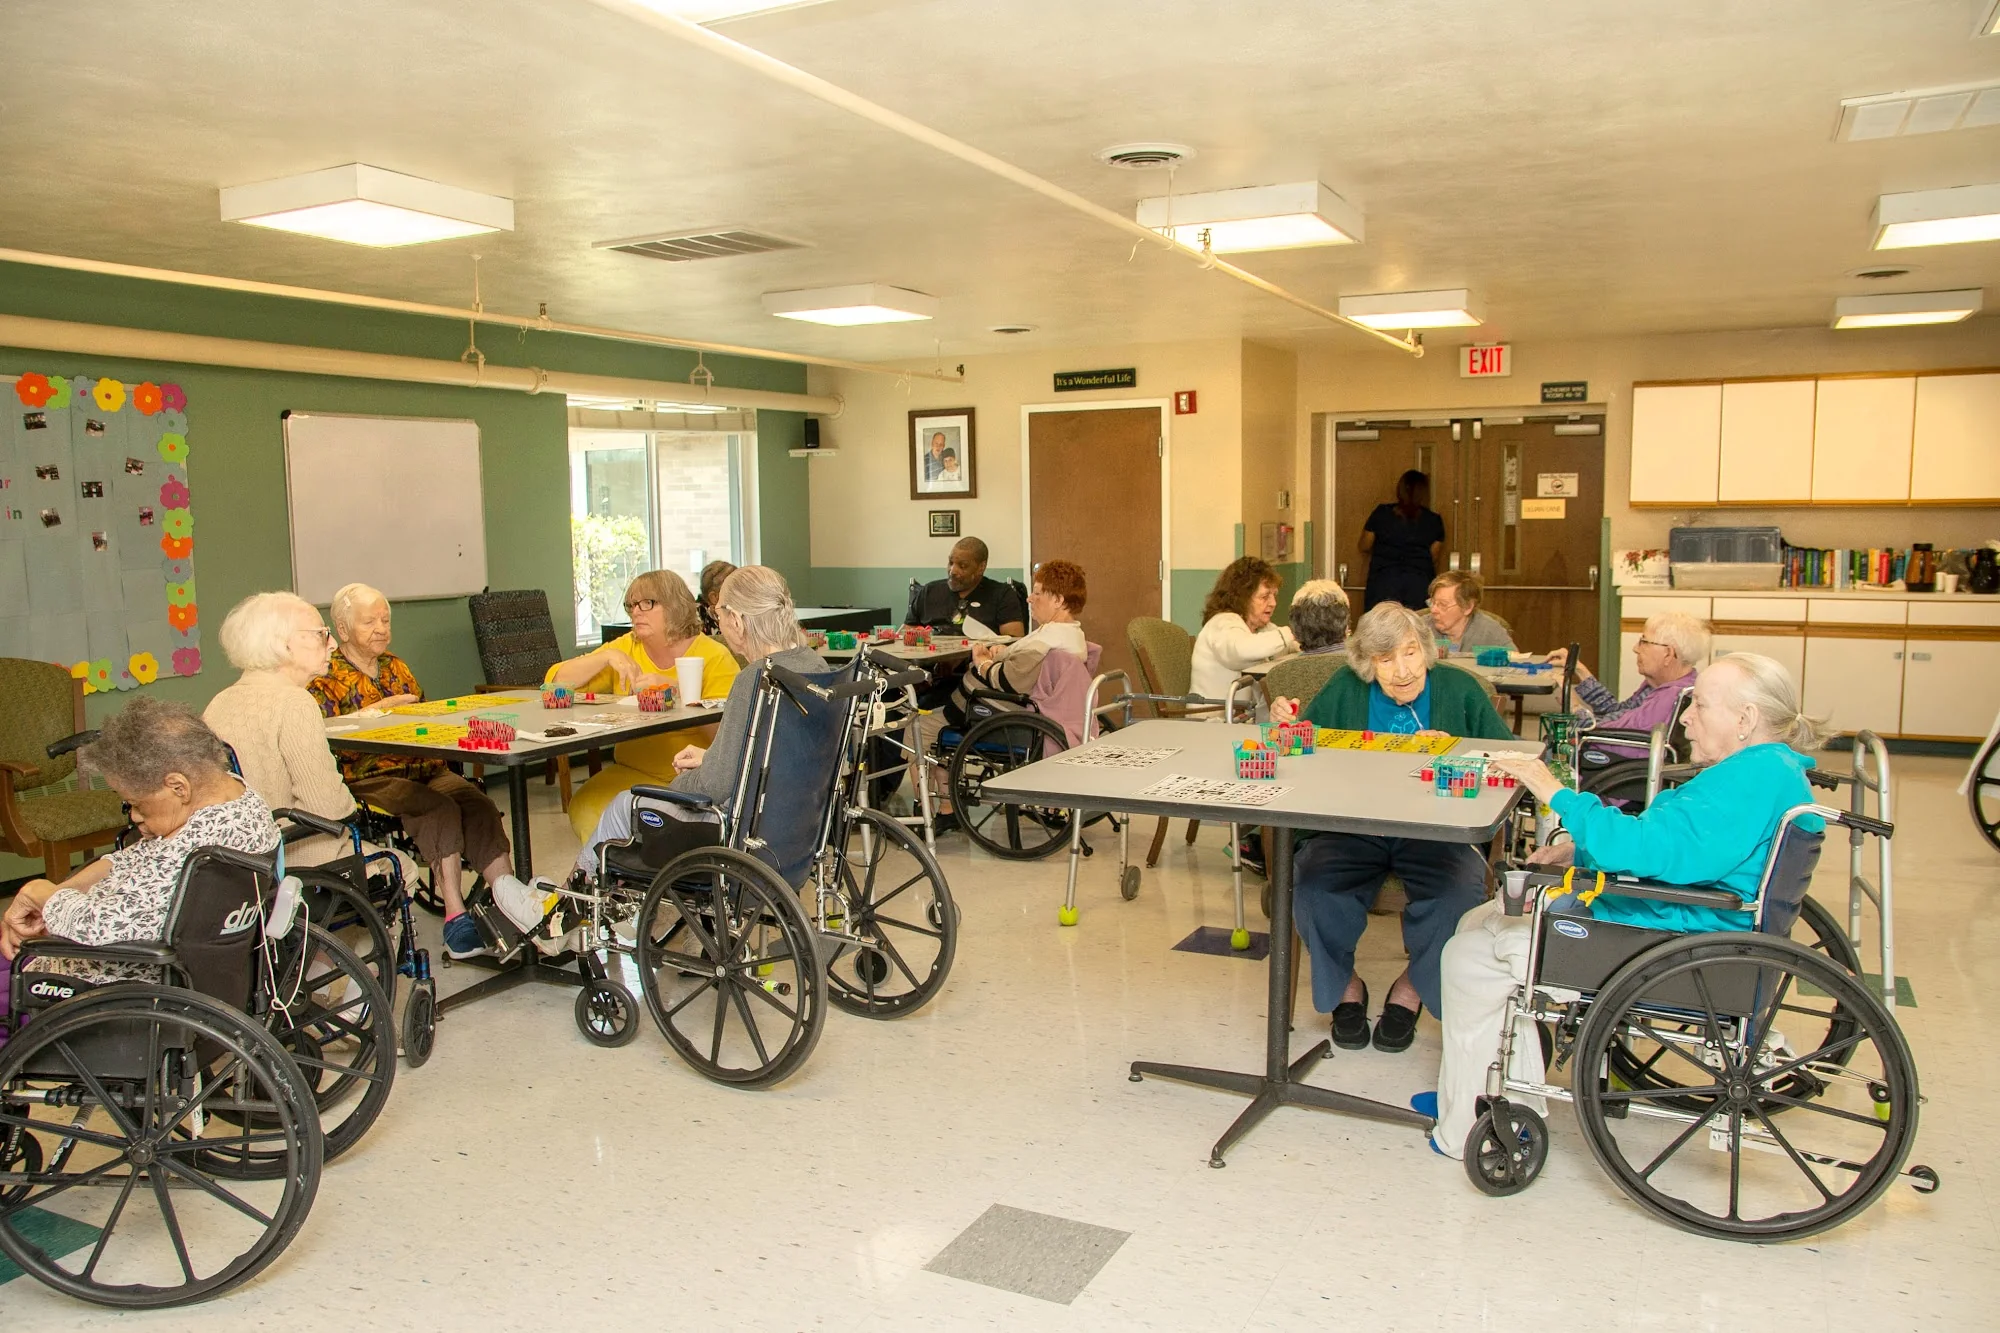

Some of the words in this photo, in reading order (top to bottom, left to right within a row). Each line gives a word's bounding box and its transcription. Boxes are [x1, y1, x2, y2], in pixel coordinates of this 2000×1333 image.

[1468, 347, 1504, 374] EXIT
[1056, 377, 1067, 386] It's
[1068, 378, 1073, 386] a
[1074, 374, 1115, 386] Wonderful
[1116, 373, 1132, 383] Life
[31, 981, 73, 998] drive
